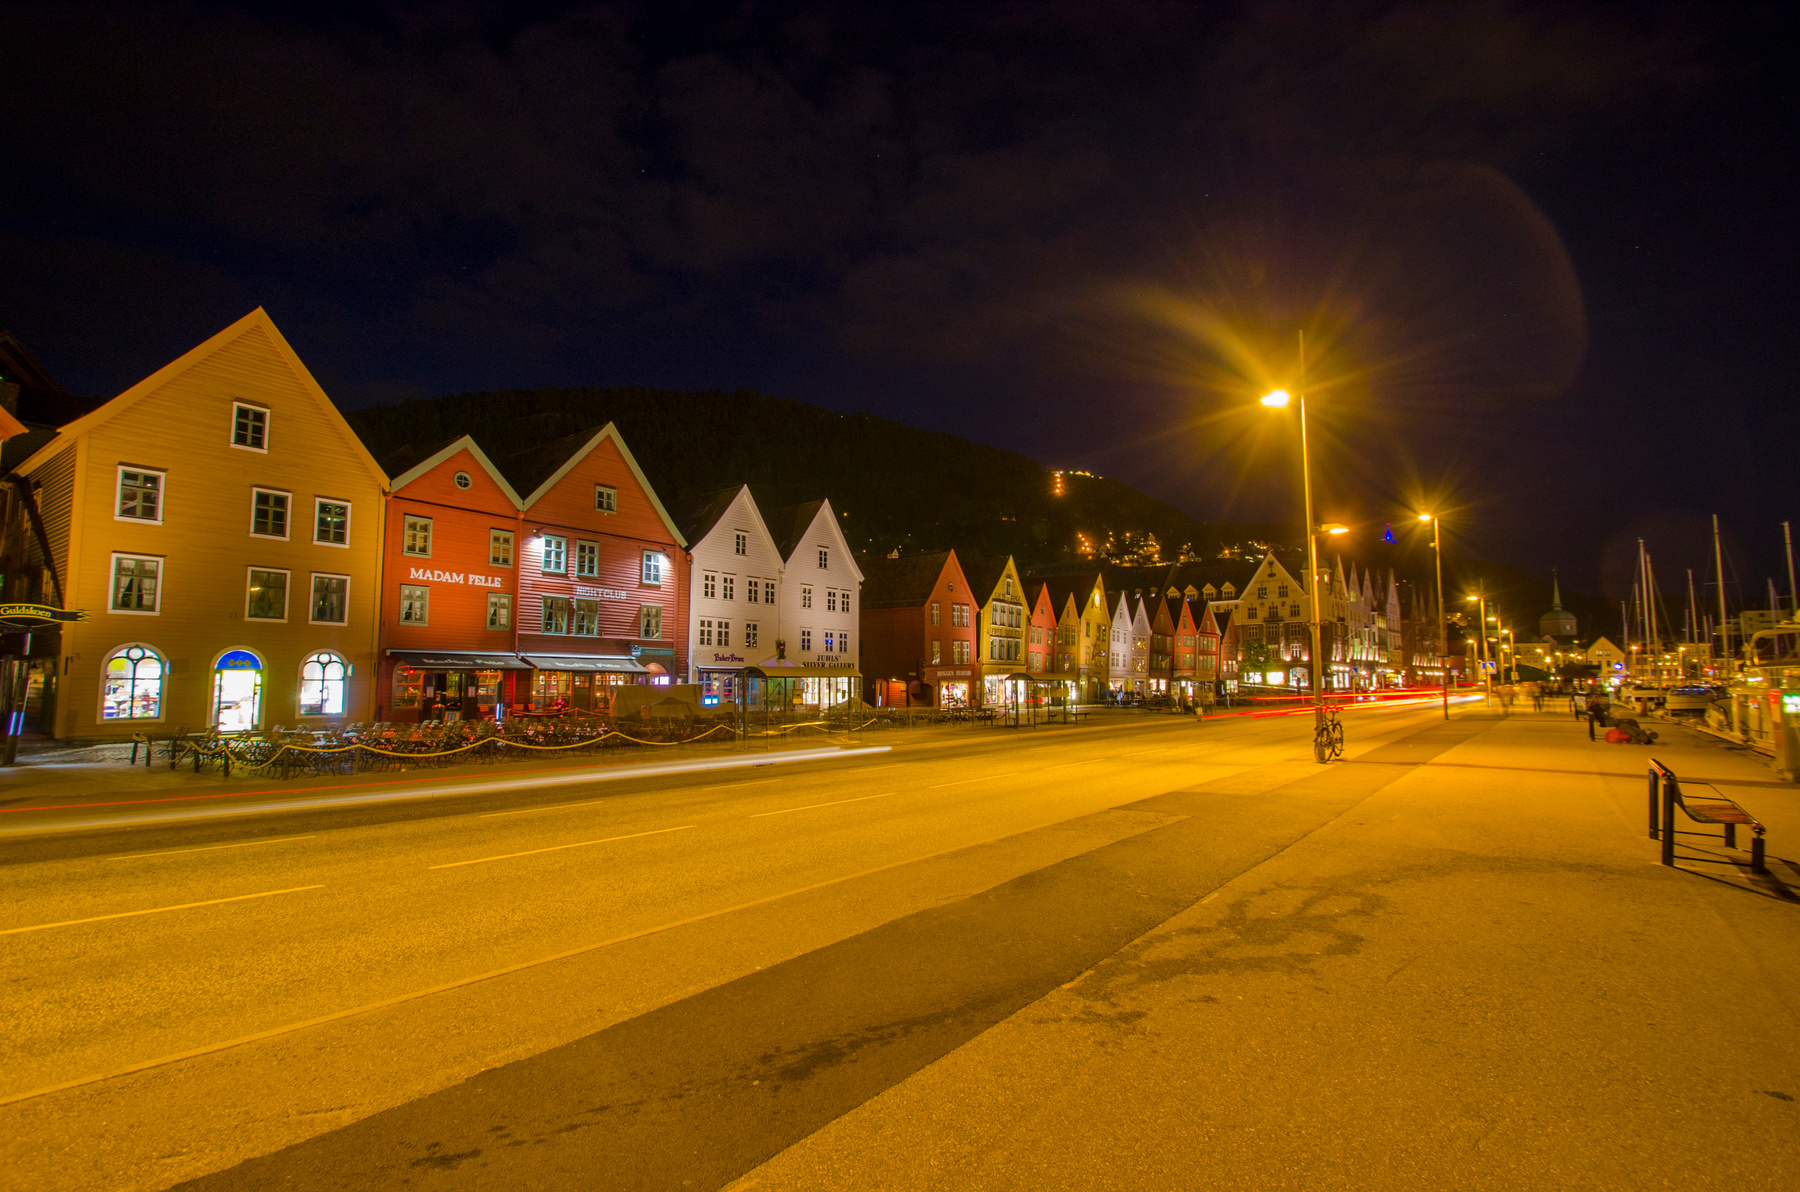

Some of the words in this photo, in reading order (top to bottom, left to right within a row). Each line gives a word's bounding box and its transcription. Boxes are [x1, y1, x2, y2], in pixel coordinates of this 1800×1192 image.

[410, 567, 464, 584] MADAM
[468, 573, 502, 588] FELLE
[576, 586, 627, 600] NIGHTCLUB
[0, 606, 52, 618] Guldskoen
